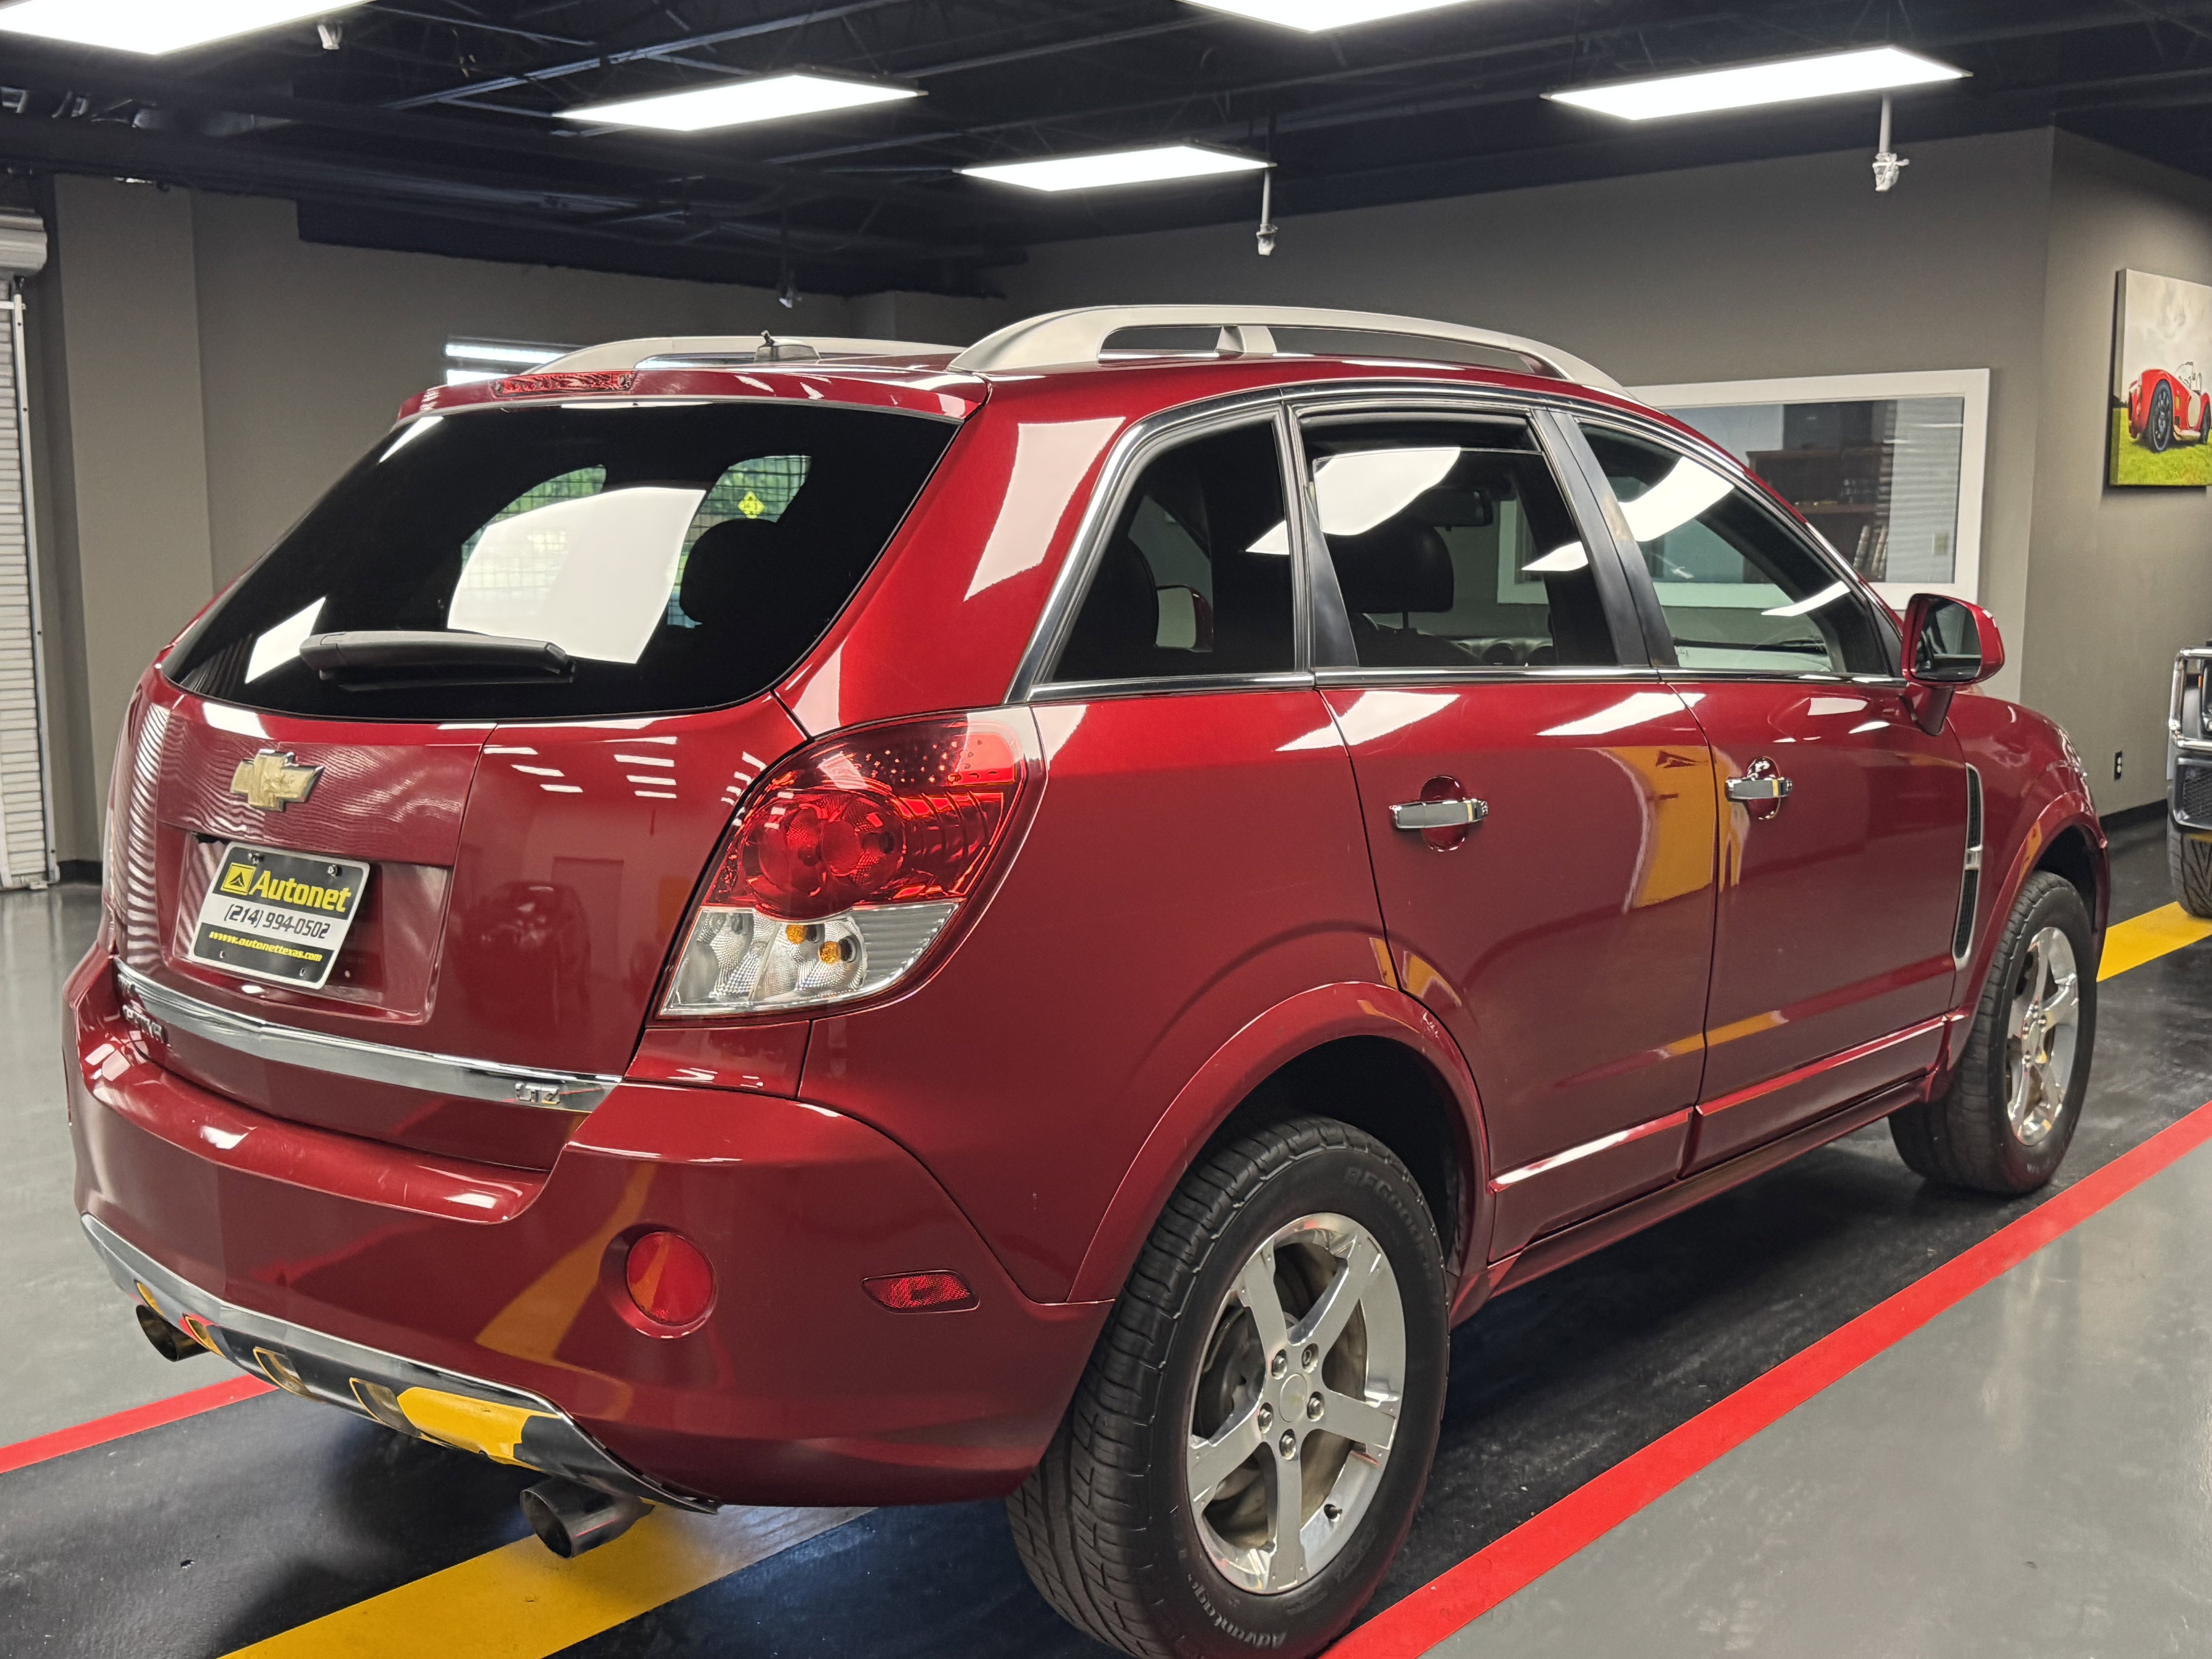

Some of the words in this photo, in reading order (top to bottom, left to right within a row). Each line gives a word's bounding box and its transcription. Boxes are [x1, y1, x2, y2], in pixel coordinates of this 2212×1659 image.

[249, 870, 351, 912] Autonet
[224, 904, 264, 928] (214)
[263, 912, 331, 939] 994-0502
[209, 931, 323, 962] www.autonettexas.com
